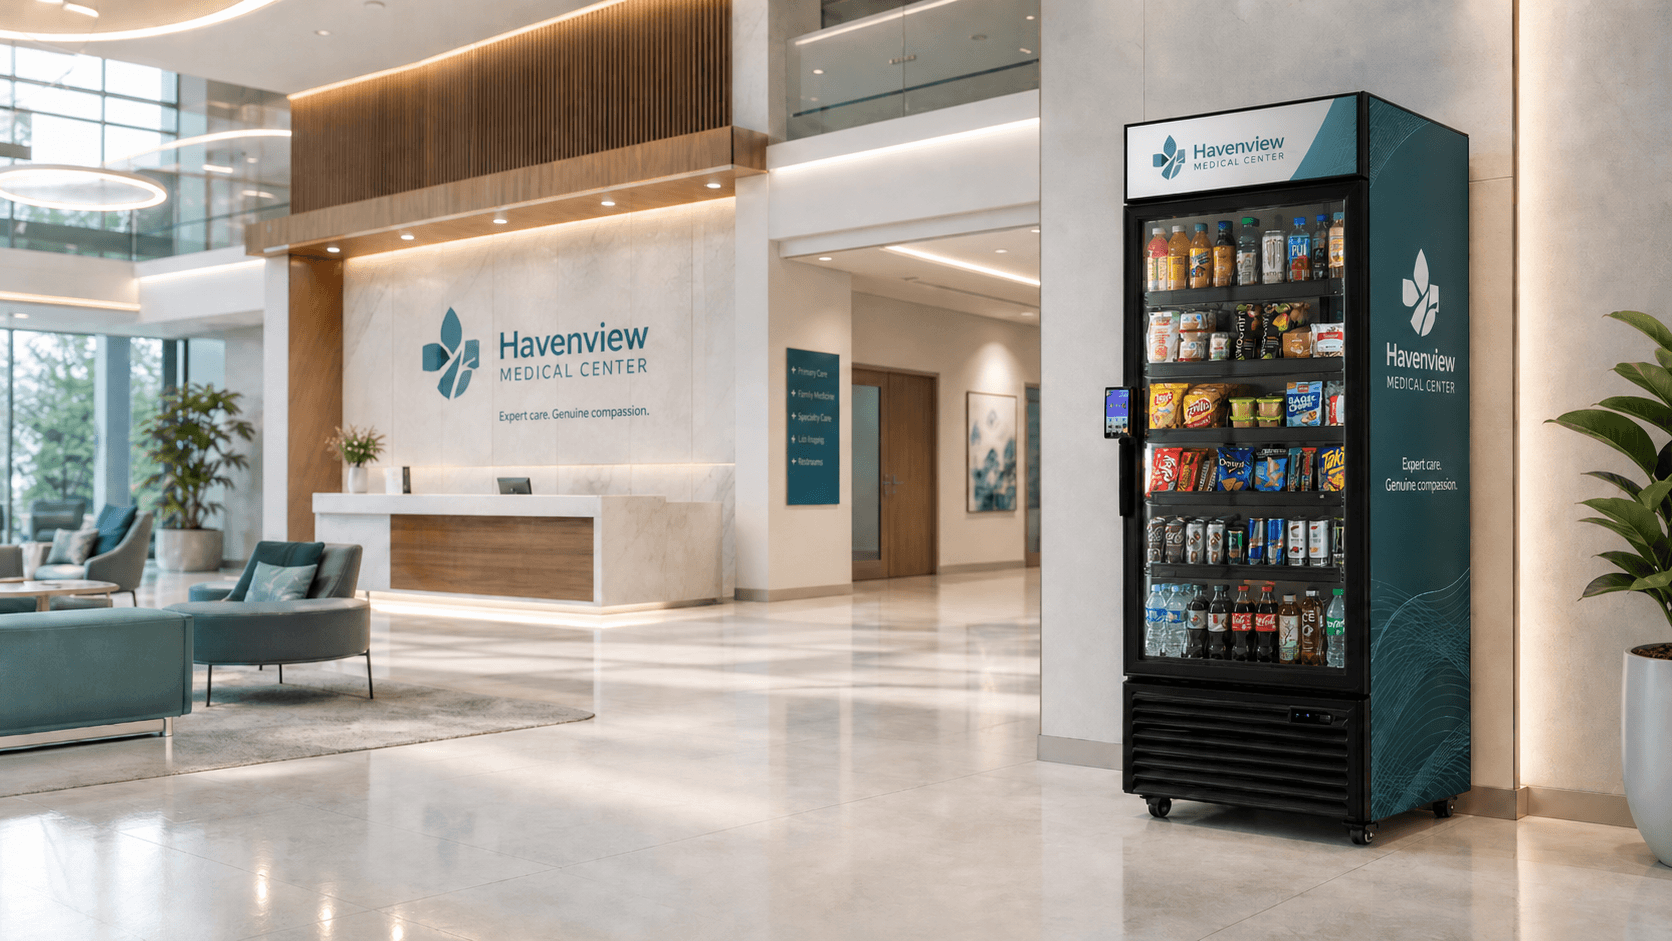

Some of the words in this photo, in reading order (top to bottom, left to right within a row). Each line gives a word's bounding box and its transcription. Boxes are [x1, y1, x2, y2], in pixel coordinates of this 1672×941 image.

[1194, 136, 1285, 160] Havenview
[1194, 158, 1239, 171] MEDICAL
[1244, 152, 1285, 165] CENTER
[500, 321, 649, 360] Havenview
[1386, 342, 1455, 372] Havenview
[500, 363, 573, 382] MEDICAL
[580, 358, 648, 377] CENTER
[798, 367, 816, 379] Primary
[817, 369, 828, 378] Care
[1386, 375, 1424, 392] MEDICAL
[1426, 379, 1455, 394] CENTER
[798, 389, 813, 400] Family
[814, 391, 835, 400] Medicine
[499, 411, 528, 424] Expert
[529, 411, 550, 421] care.
[552, 407, 589, 420] Genuine
[590, 405, 650, 420] compassion.
[798, 412, 819, 424] Specialty
[820, 413, 832, 422] Care
[1402, 457, 1425, 473] Expert
[1426, 459, 1442, 471] care.
[1385, 478, 1417, 492] Genuine
[1417, 478, 1458, 494] compassion.
